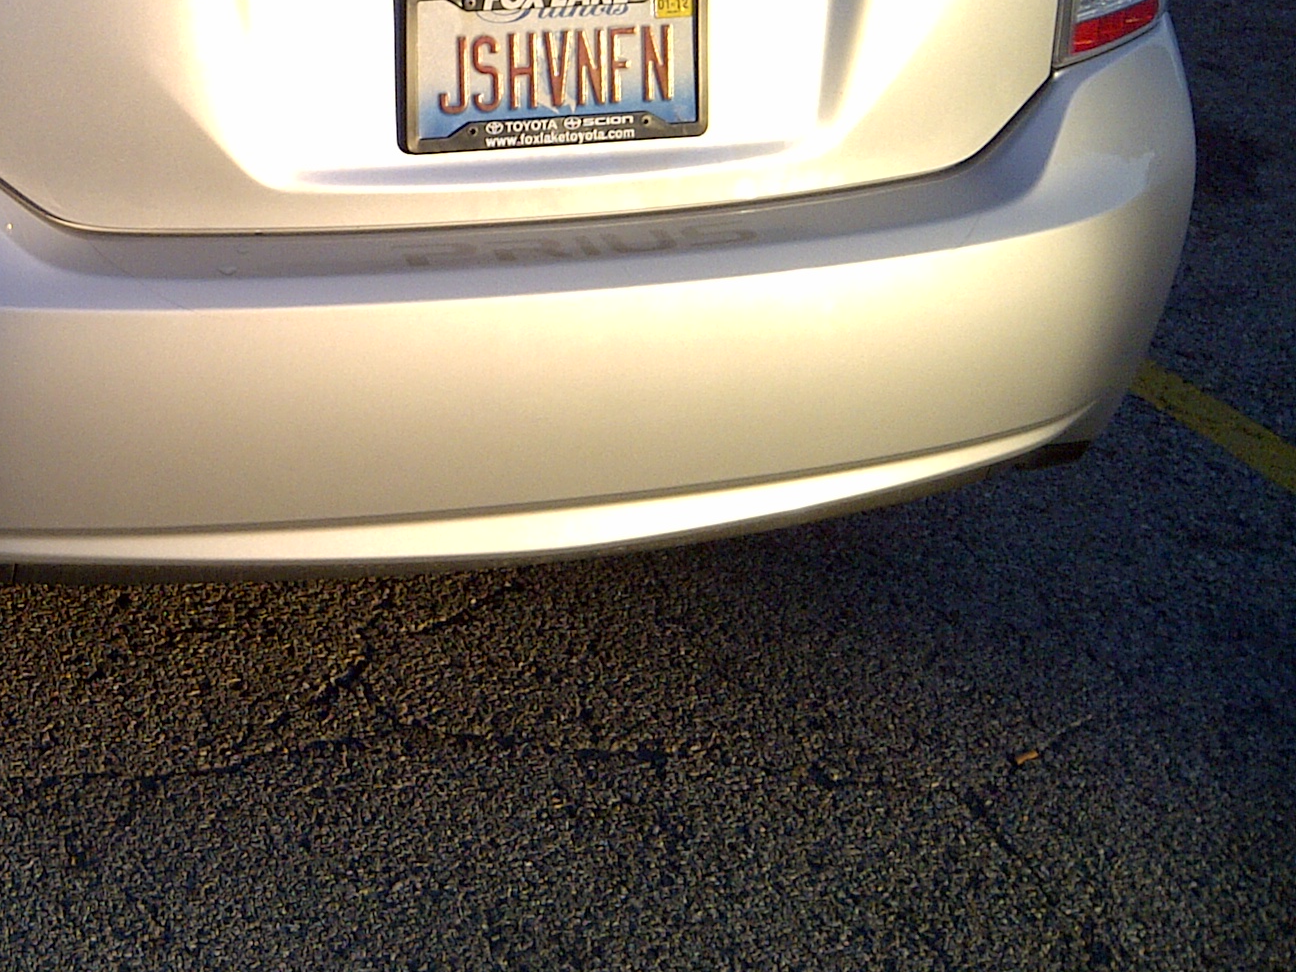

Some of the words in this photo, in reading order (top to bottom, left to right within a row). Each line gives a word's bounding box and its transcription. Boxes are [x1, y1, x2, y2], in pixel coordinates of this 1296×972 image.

[438, 24, 675, 115] JSHVNFN
[505, 118, 558, 133] TOYOTA
[484, 128, 636, 148] www.foxlaketoyota.com
